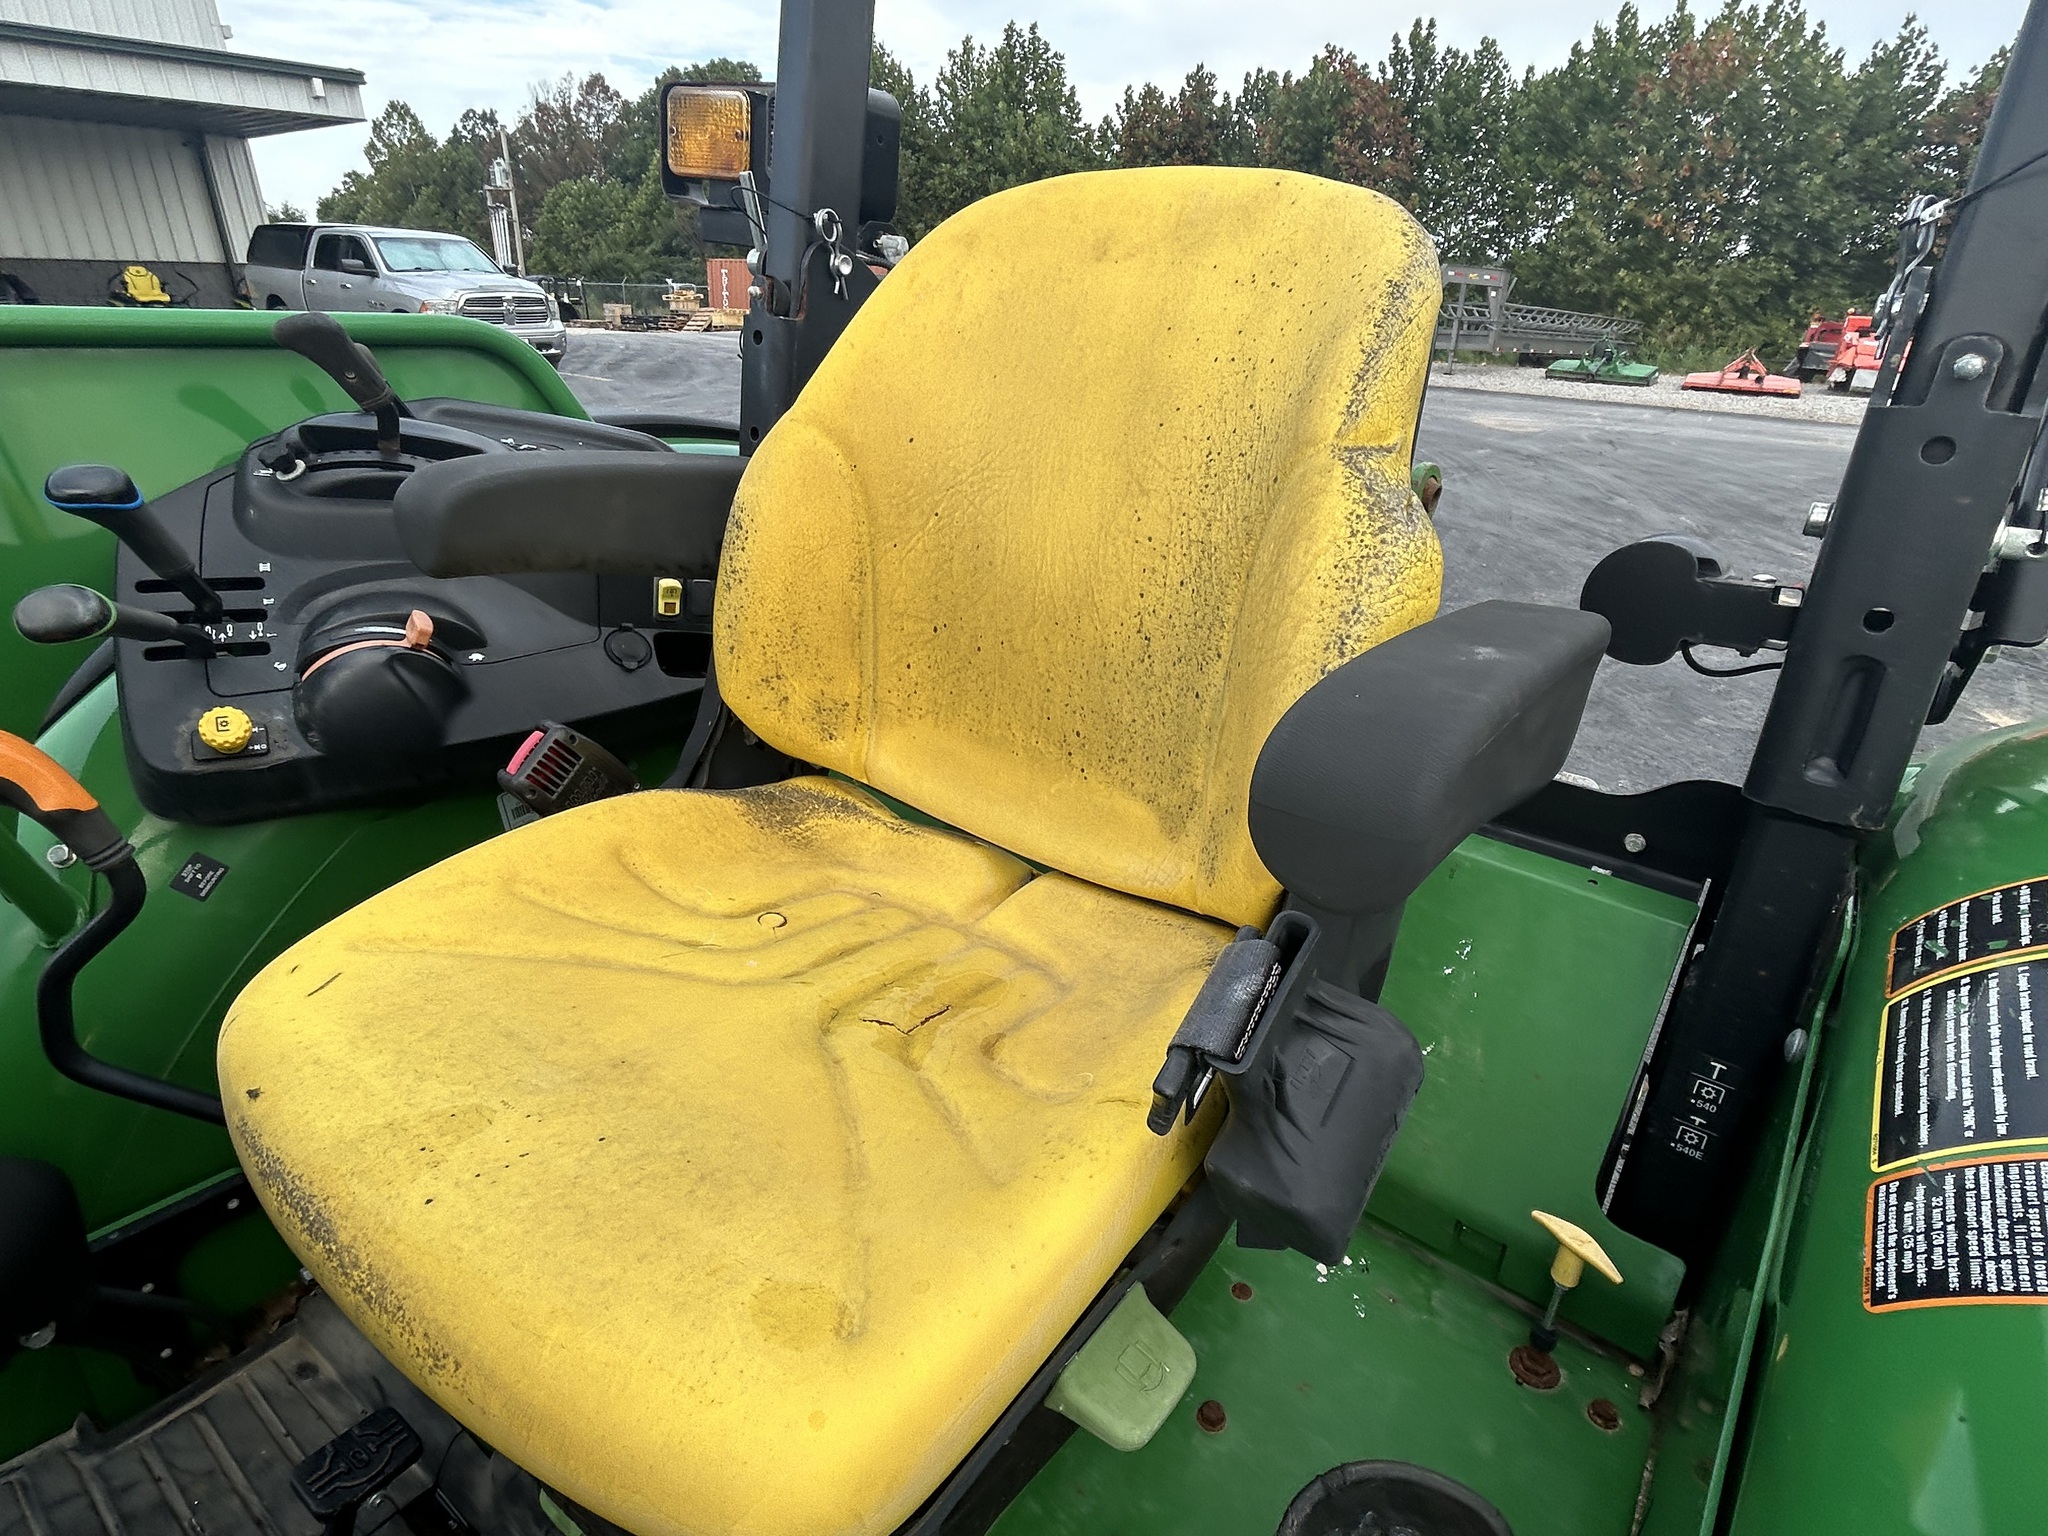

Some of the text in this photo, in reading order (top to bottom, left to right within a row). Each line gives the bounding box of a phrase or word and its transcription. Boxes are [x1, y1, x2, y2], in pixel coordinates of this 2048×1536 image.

[181, 864, 192, 877] STOP
[198, 870, 215, 889] BEFORE
[200, 868, 224, 897] DISMOUNTING
[2023, 1058, 2040, 1081] travel.
[1979, 1166, 1991, 1200] maximum
[1930, 1196, 1945, 1270] 32 km/h (20 mph)
[1964, 1167, 1983, 1288] these transport speed limits:
[1979, 1201, 1995, 1233] transport
[1997, 1218, 2010, 1239] does
[2007, 1163, 2033, 1292] implements. If implement
[2024, 1161, 2048, 1293] transport speed for towed
[1874, 1185, 1887, 1291] maximum transport speed.
[1885, 1181, 1900, 1300] Do not exceed the implement's
[1901, 1201, 1914, 1273] 40 km/h (25 mph)
[1916, 1234, 1927, 1253] with
[1946, 1224, 1958, 1256] without
[1999, 1240, 2012, 1255] not
[1916, 1254, 1927, 1287] brakes:
[1948, 1258, 1960, 1291] brakes:
[1985, 1260, 1999, 1293] observe
[2000, 1259, 2017, 1292] specify
